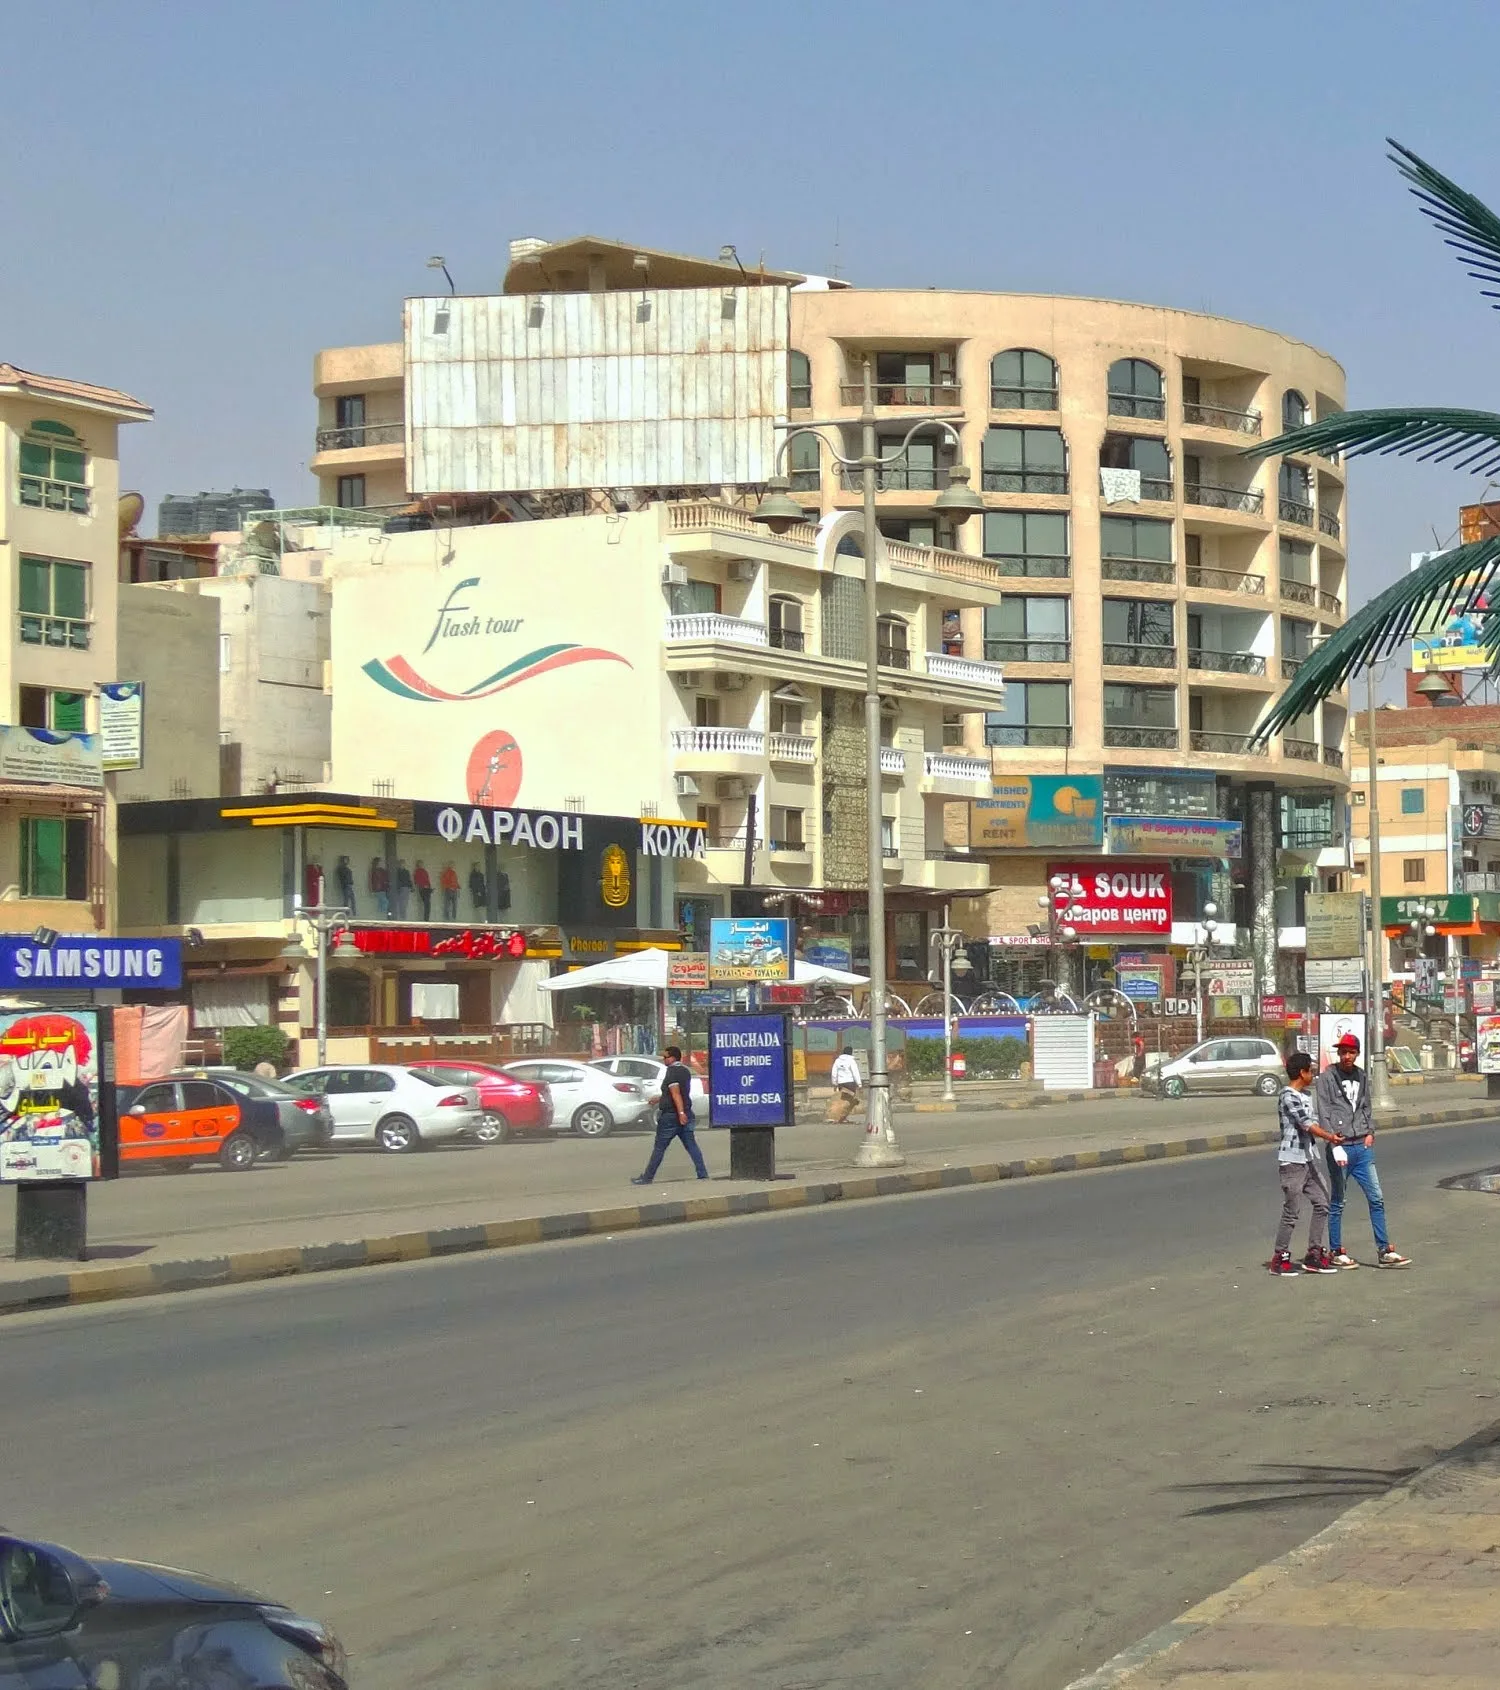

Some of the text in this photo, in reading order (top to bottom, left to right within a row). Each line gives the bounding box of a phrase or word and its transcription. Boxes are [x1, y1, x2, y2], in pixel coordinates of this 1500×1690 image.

[486, 617, 524, 634] tour
[993, 786, 1029, 795] NISHED
[976, 800, 1025, 808] APARTMENTS
[437, 807, 583, 851] ФАРАОН
[982, 828, 1016, 838] RENT
[642, 823, 706, 858] КОЖА
[1094, 873, 1166, 898] SOUK
[1123, 908, 1167, 925] центр
[1009, 936, 1032, 945] SPORT
[1035, 936, 1051, 944] SHO
[15, 948, 162, 978] SAMSUNG
[715, 1033, 781, 1048] HURGHADA
[722, 1055, 772, 1067] THE BRIDE
[741, 1075, 754, 1087] OF
[716, 1094, 781, 1105] THE RED SEA
